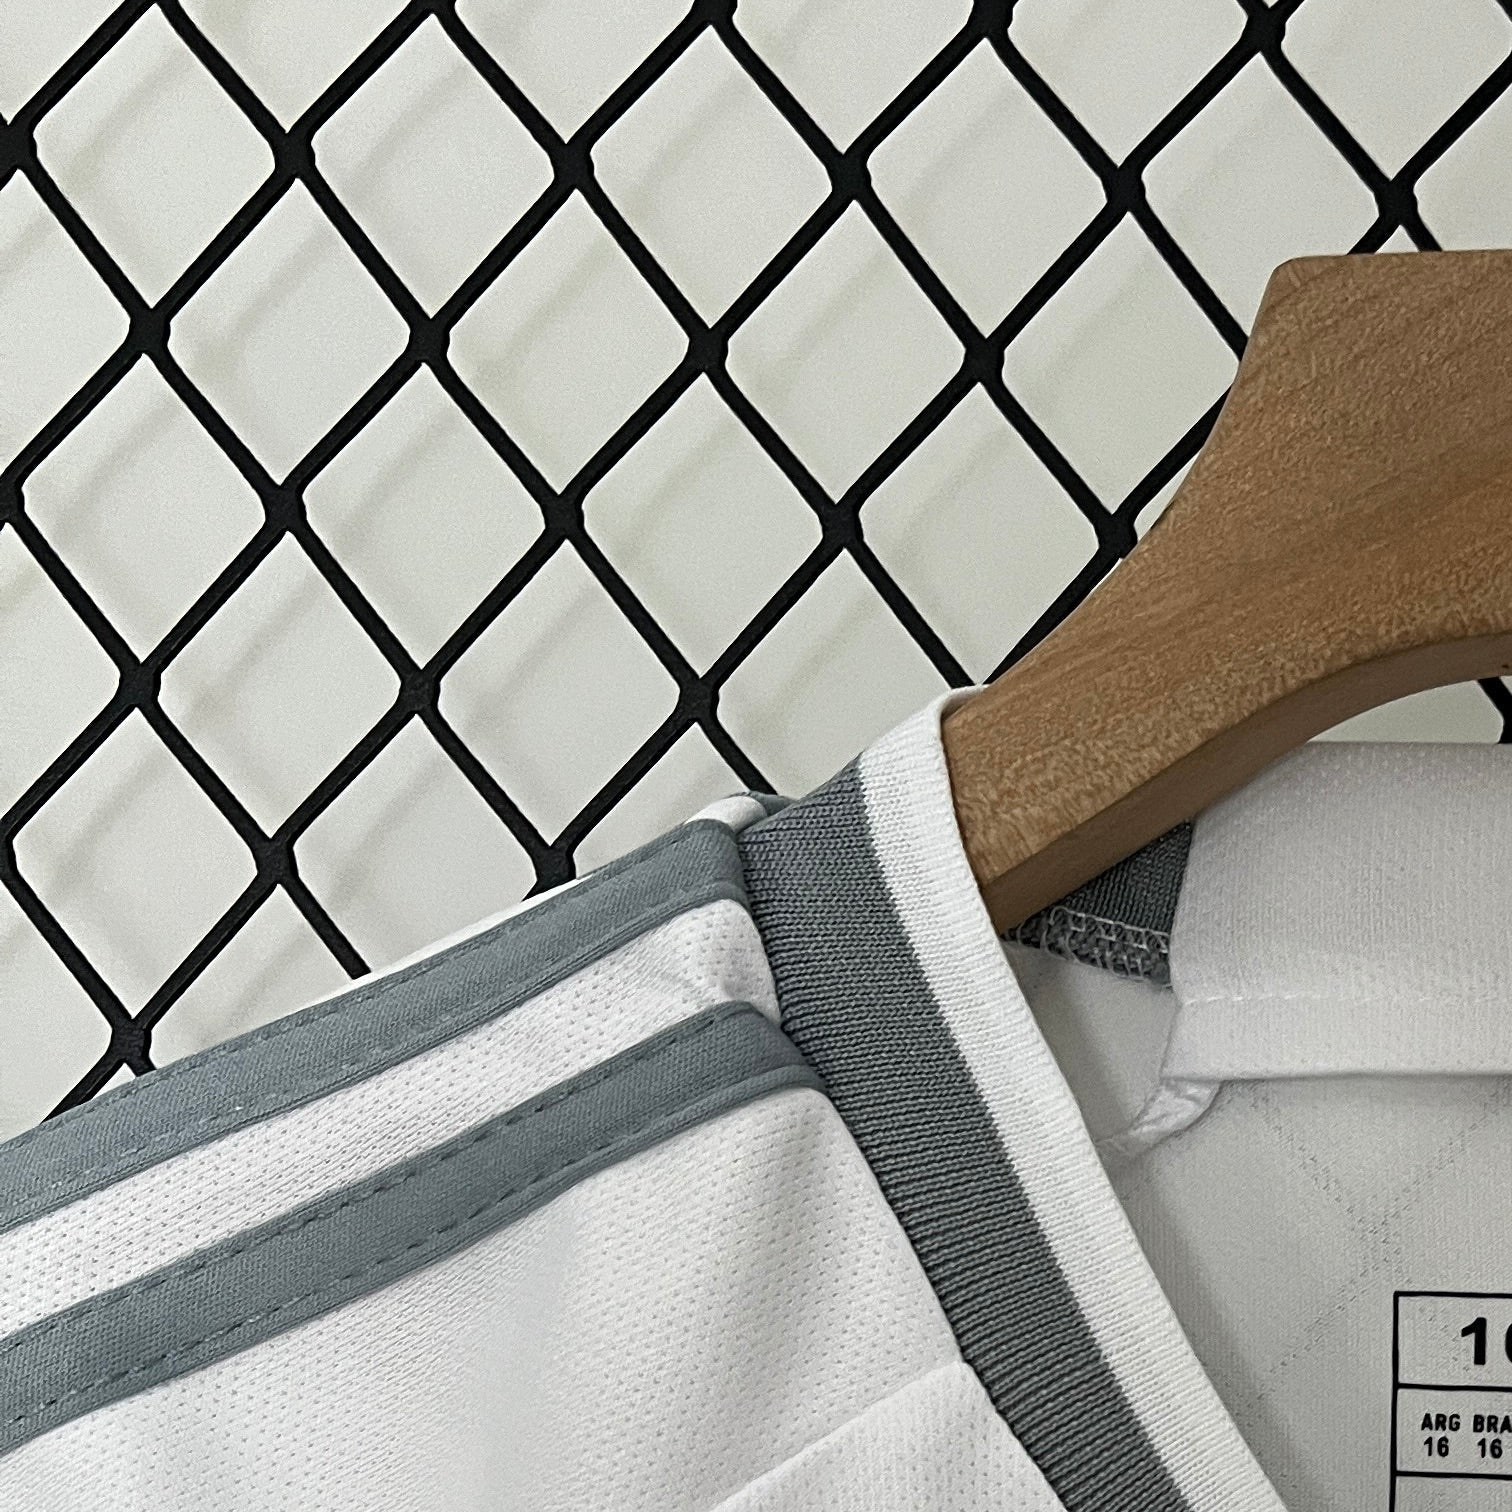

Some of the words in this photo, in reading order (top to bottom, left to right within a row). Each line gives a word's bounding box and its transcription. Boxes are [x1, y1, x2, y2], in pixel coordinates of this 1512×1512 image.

[1421, 1413, 1460, 1431] ARG
[1473, 1414, 1512, 1434] BRA
[1424, 1436, 1449, 1457] 16
[1478, 1438, 1503, 1459] 16
